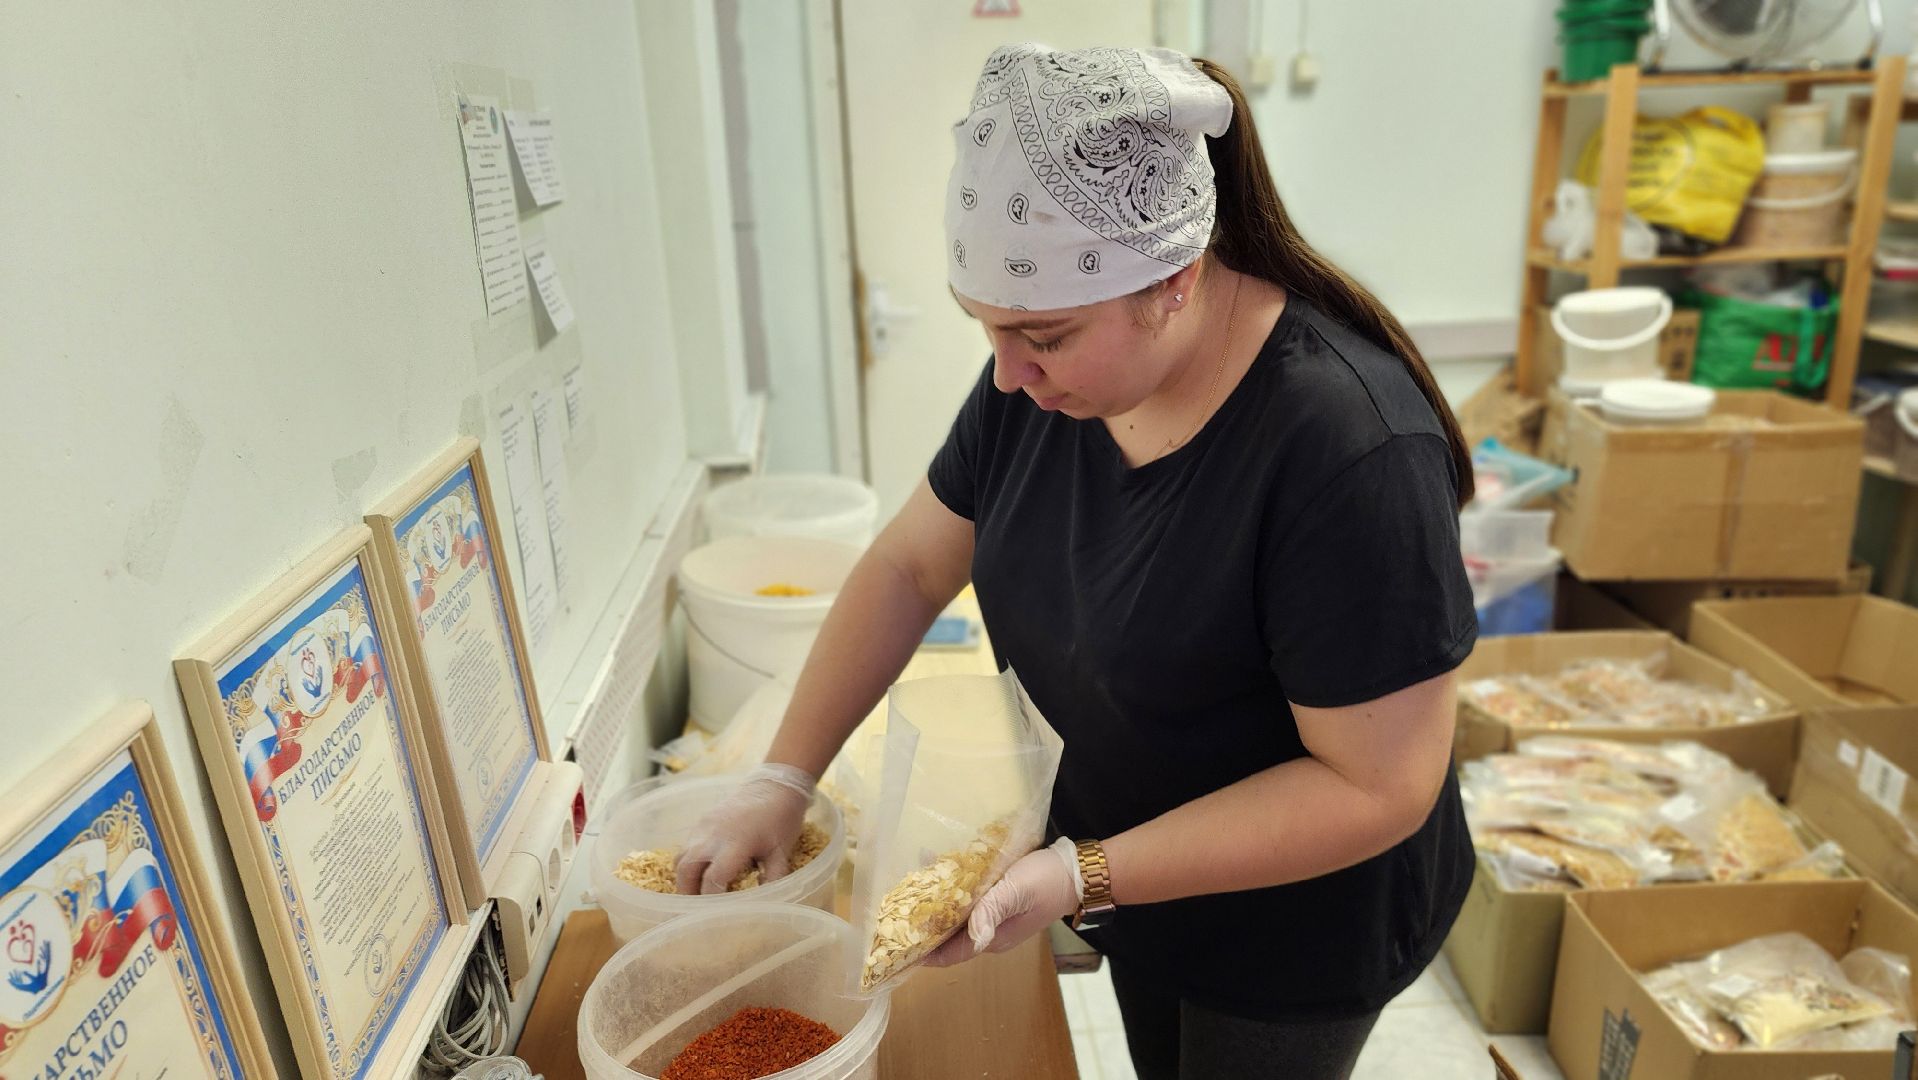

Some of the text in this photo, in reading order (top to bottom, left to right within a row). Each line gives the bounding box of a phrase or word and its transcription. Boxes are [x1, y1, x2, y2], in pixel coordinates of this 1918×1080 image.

[277, 689, 376, 806] БЛАГОДАРСТВЕННОЕ
[310, 731, 363, 801] ПИСЬМО
[68, 1019, 128, 1080] ЬМО
